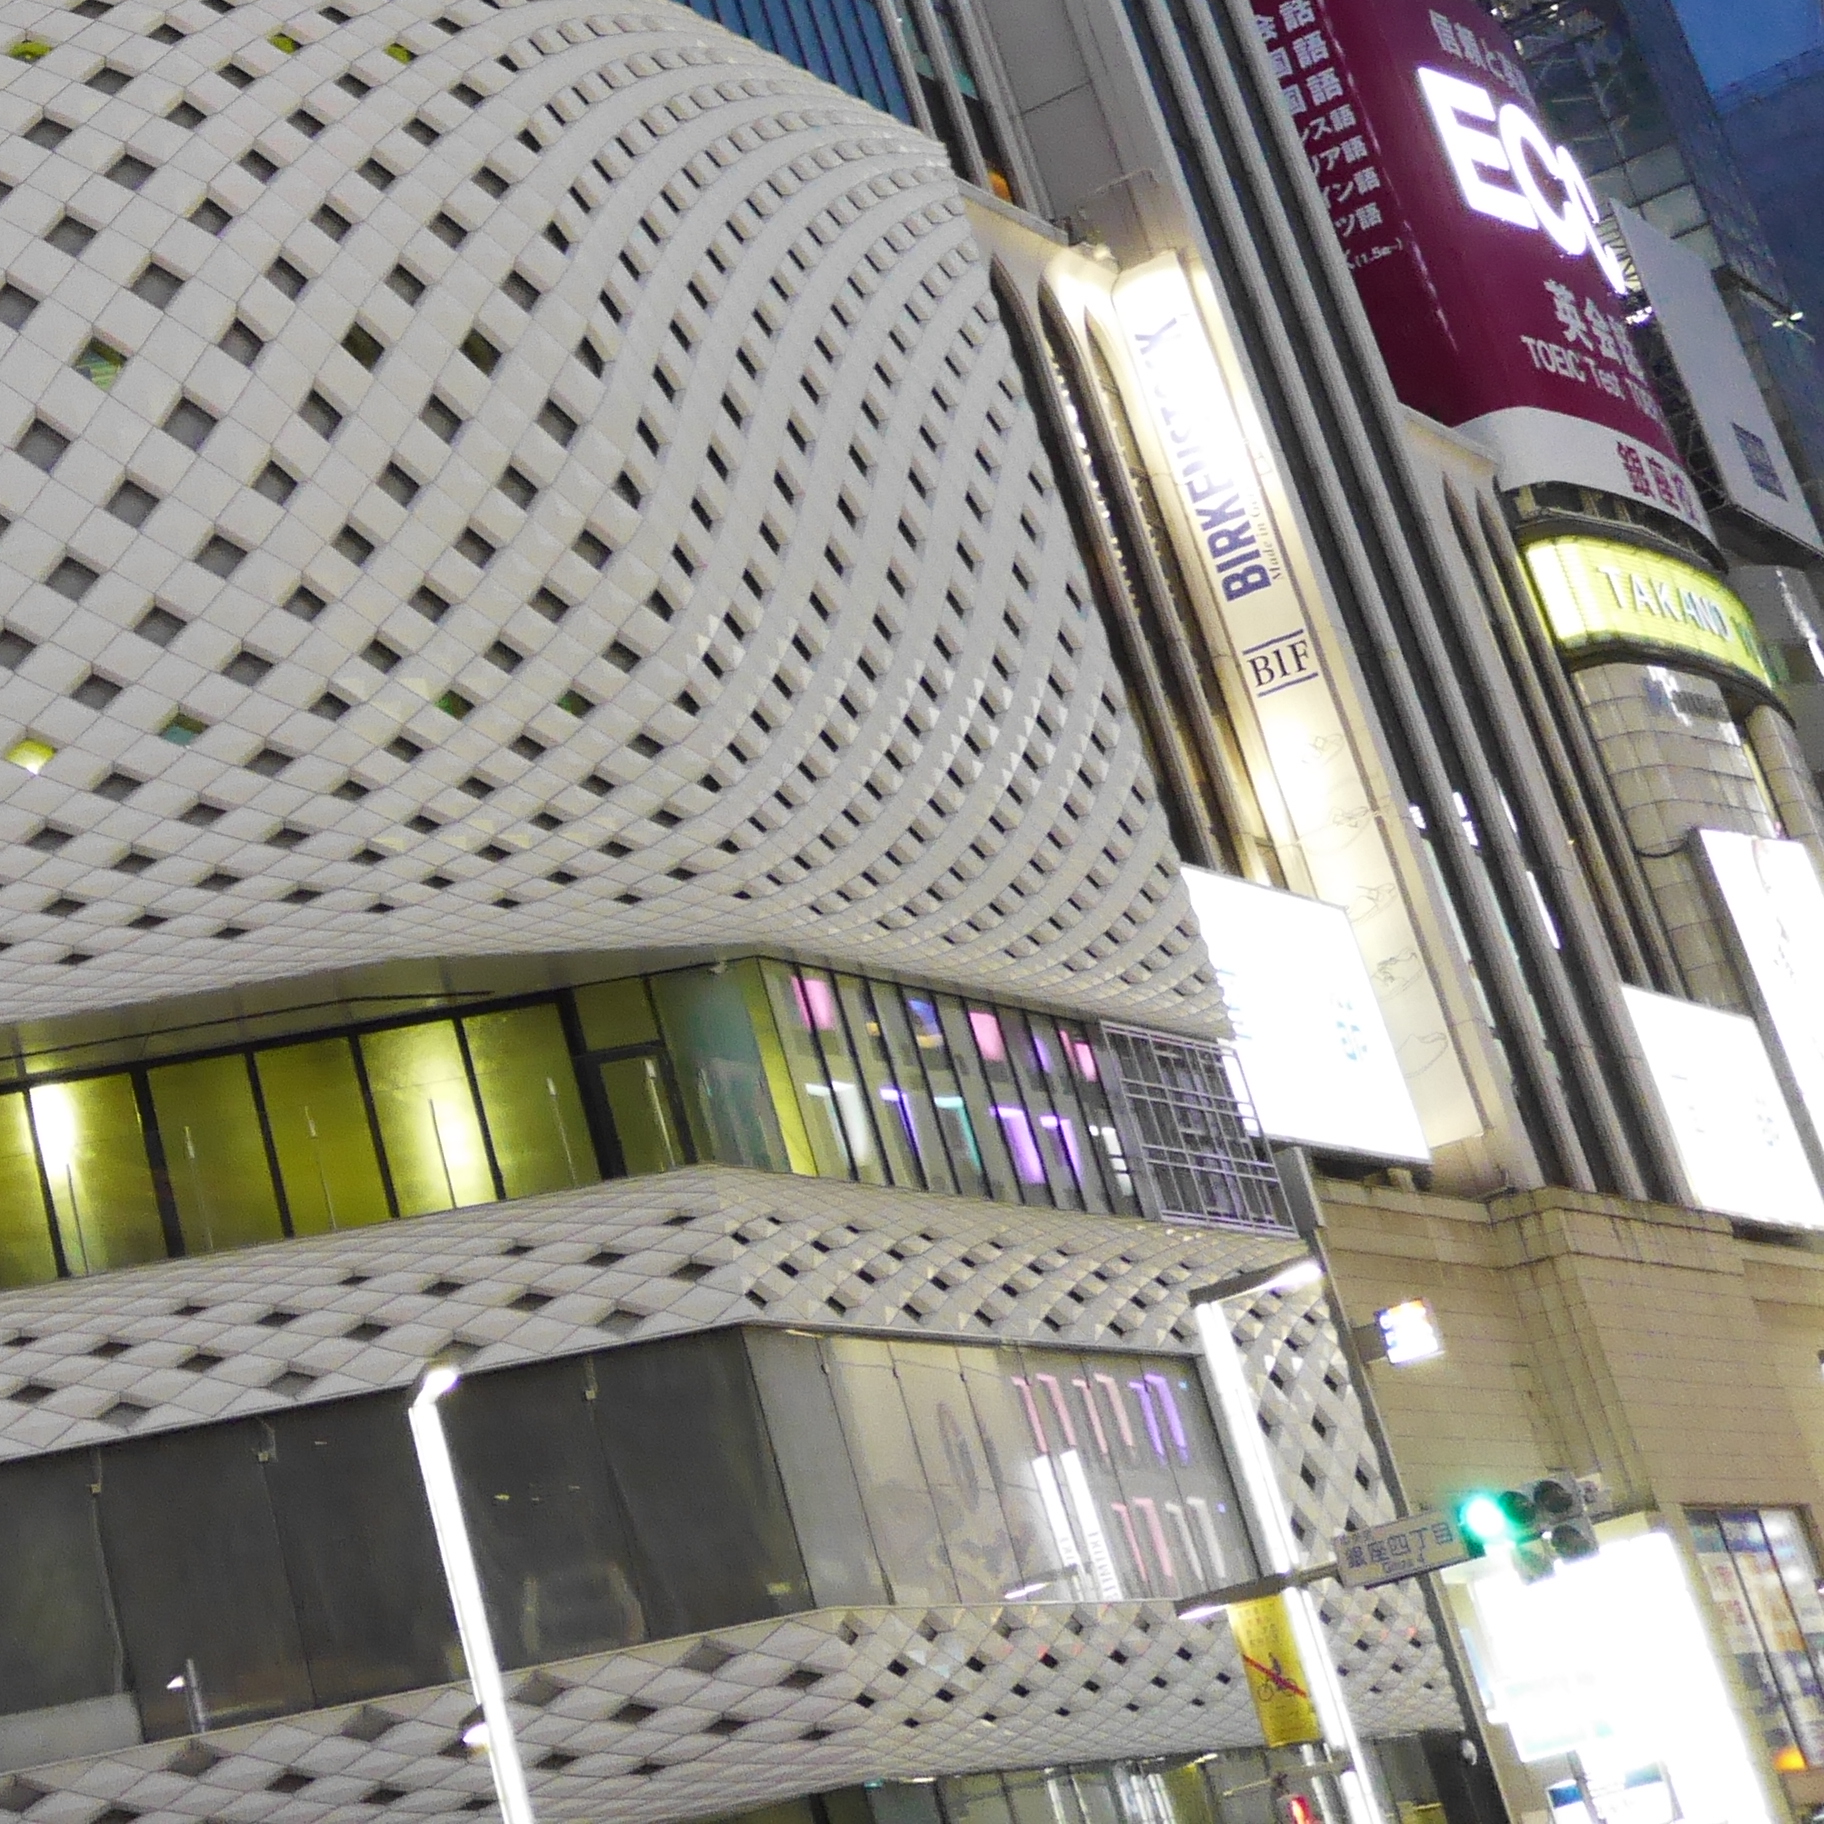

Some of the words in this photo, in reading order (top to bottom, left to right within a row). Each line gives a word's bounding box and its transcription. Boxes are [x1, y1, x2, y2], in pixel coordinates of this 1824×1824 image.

[1520, 334, 1587, 383] TOEIC
[1596, 564, 1732, 643] TAKANO
[1246, 638, 1310, 688] BIF
[1346, 1522, 1454, 1569] 銀座四丁目
